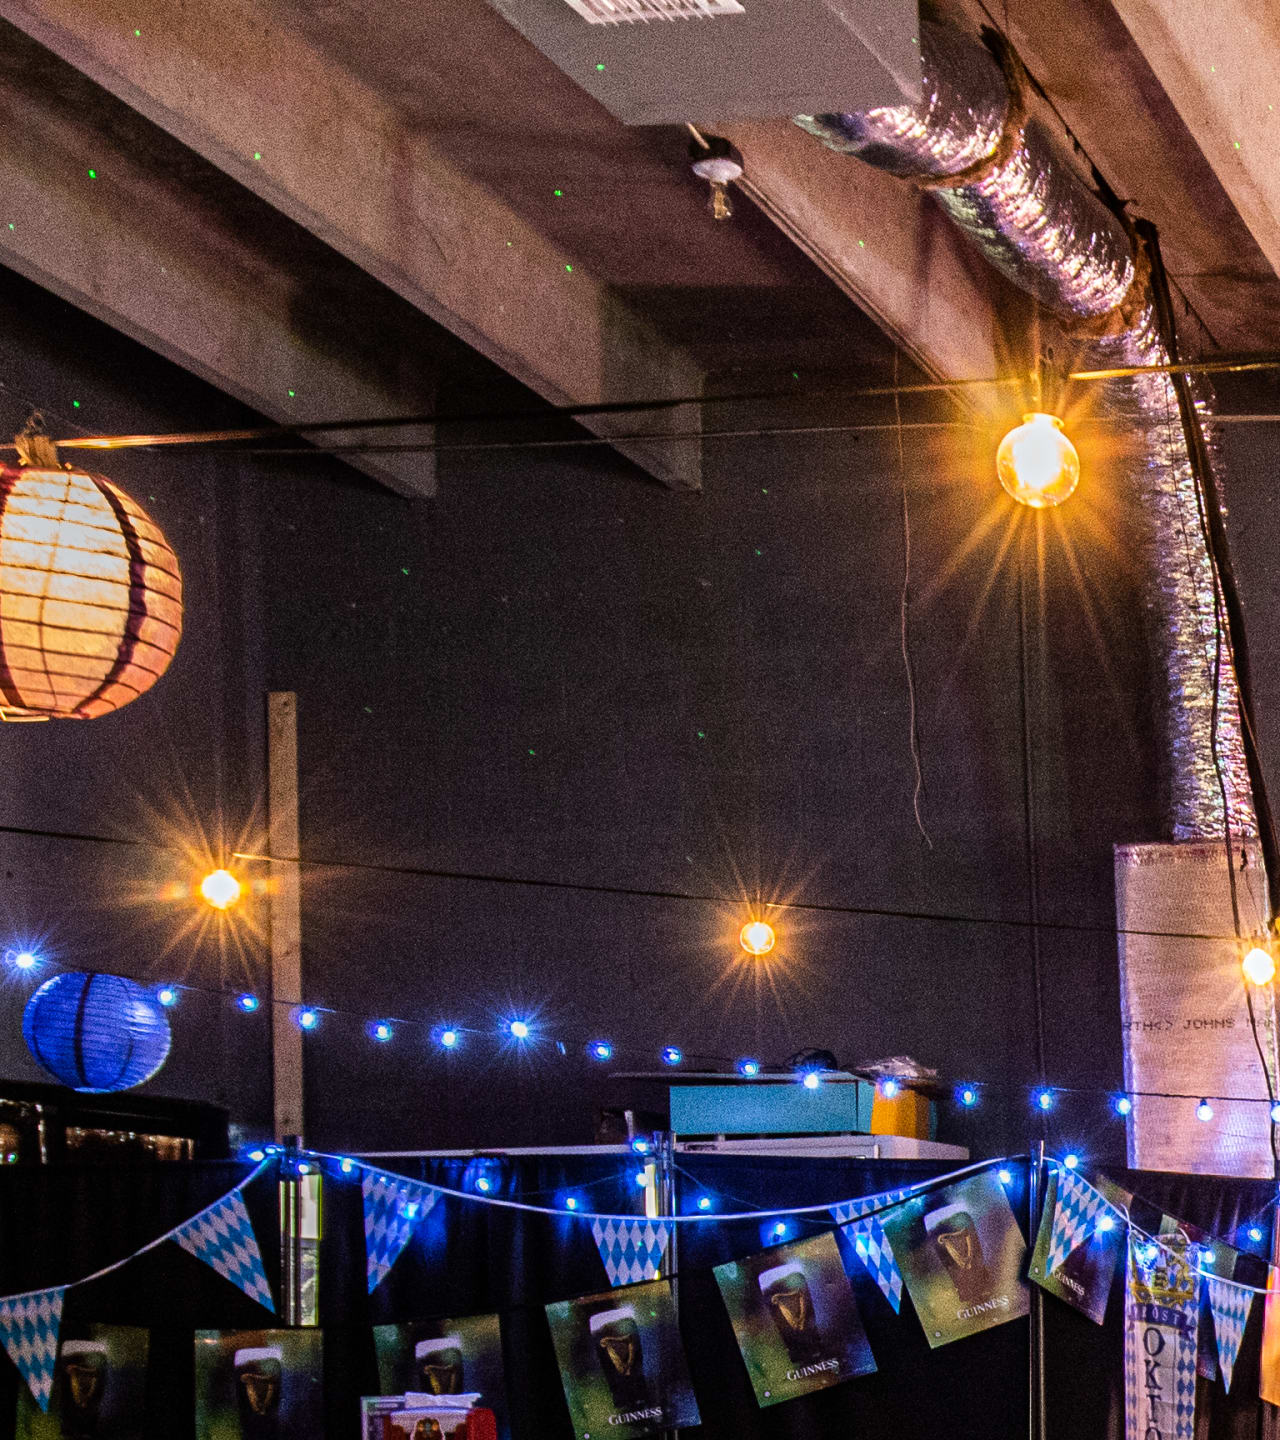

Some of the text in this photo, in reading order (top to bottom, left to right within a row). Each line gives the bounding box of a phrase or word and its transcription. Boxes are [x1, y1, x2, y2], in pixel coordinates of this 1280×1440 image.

[1052, 1269, 1086, 1297] GUINNESS
[956, 1295, 1009, 1321] GUINNESS
[786, 1358, 840, 1381] GUINNESS
[608, 1406, 663, 1426] GUINNESS
